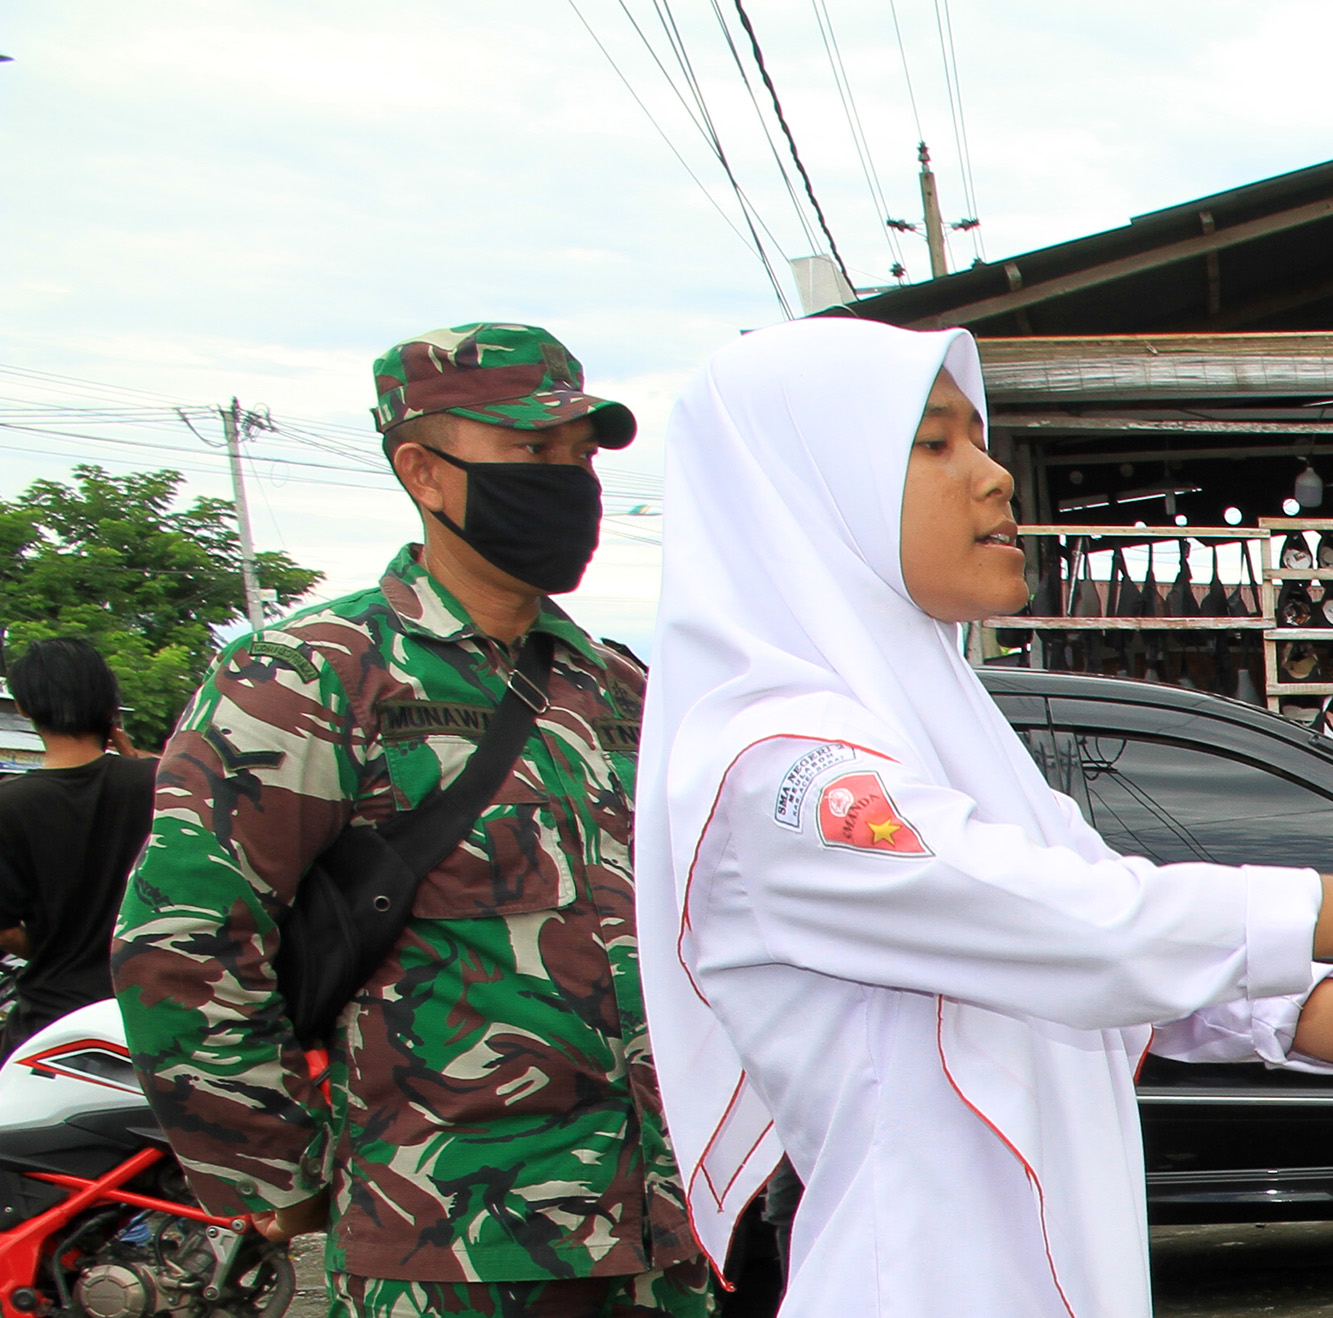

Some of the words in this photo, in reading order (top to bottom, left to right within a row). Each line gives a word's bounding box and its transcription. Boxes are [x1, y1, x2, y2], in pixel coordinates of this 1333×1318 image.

[602, 725, 640, 745] TN
[778, 787, 790, 815] SMA
[787, 745, 831, 784] NEGERI
[788, 753, 833, 803] MEULABOH
